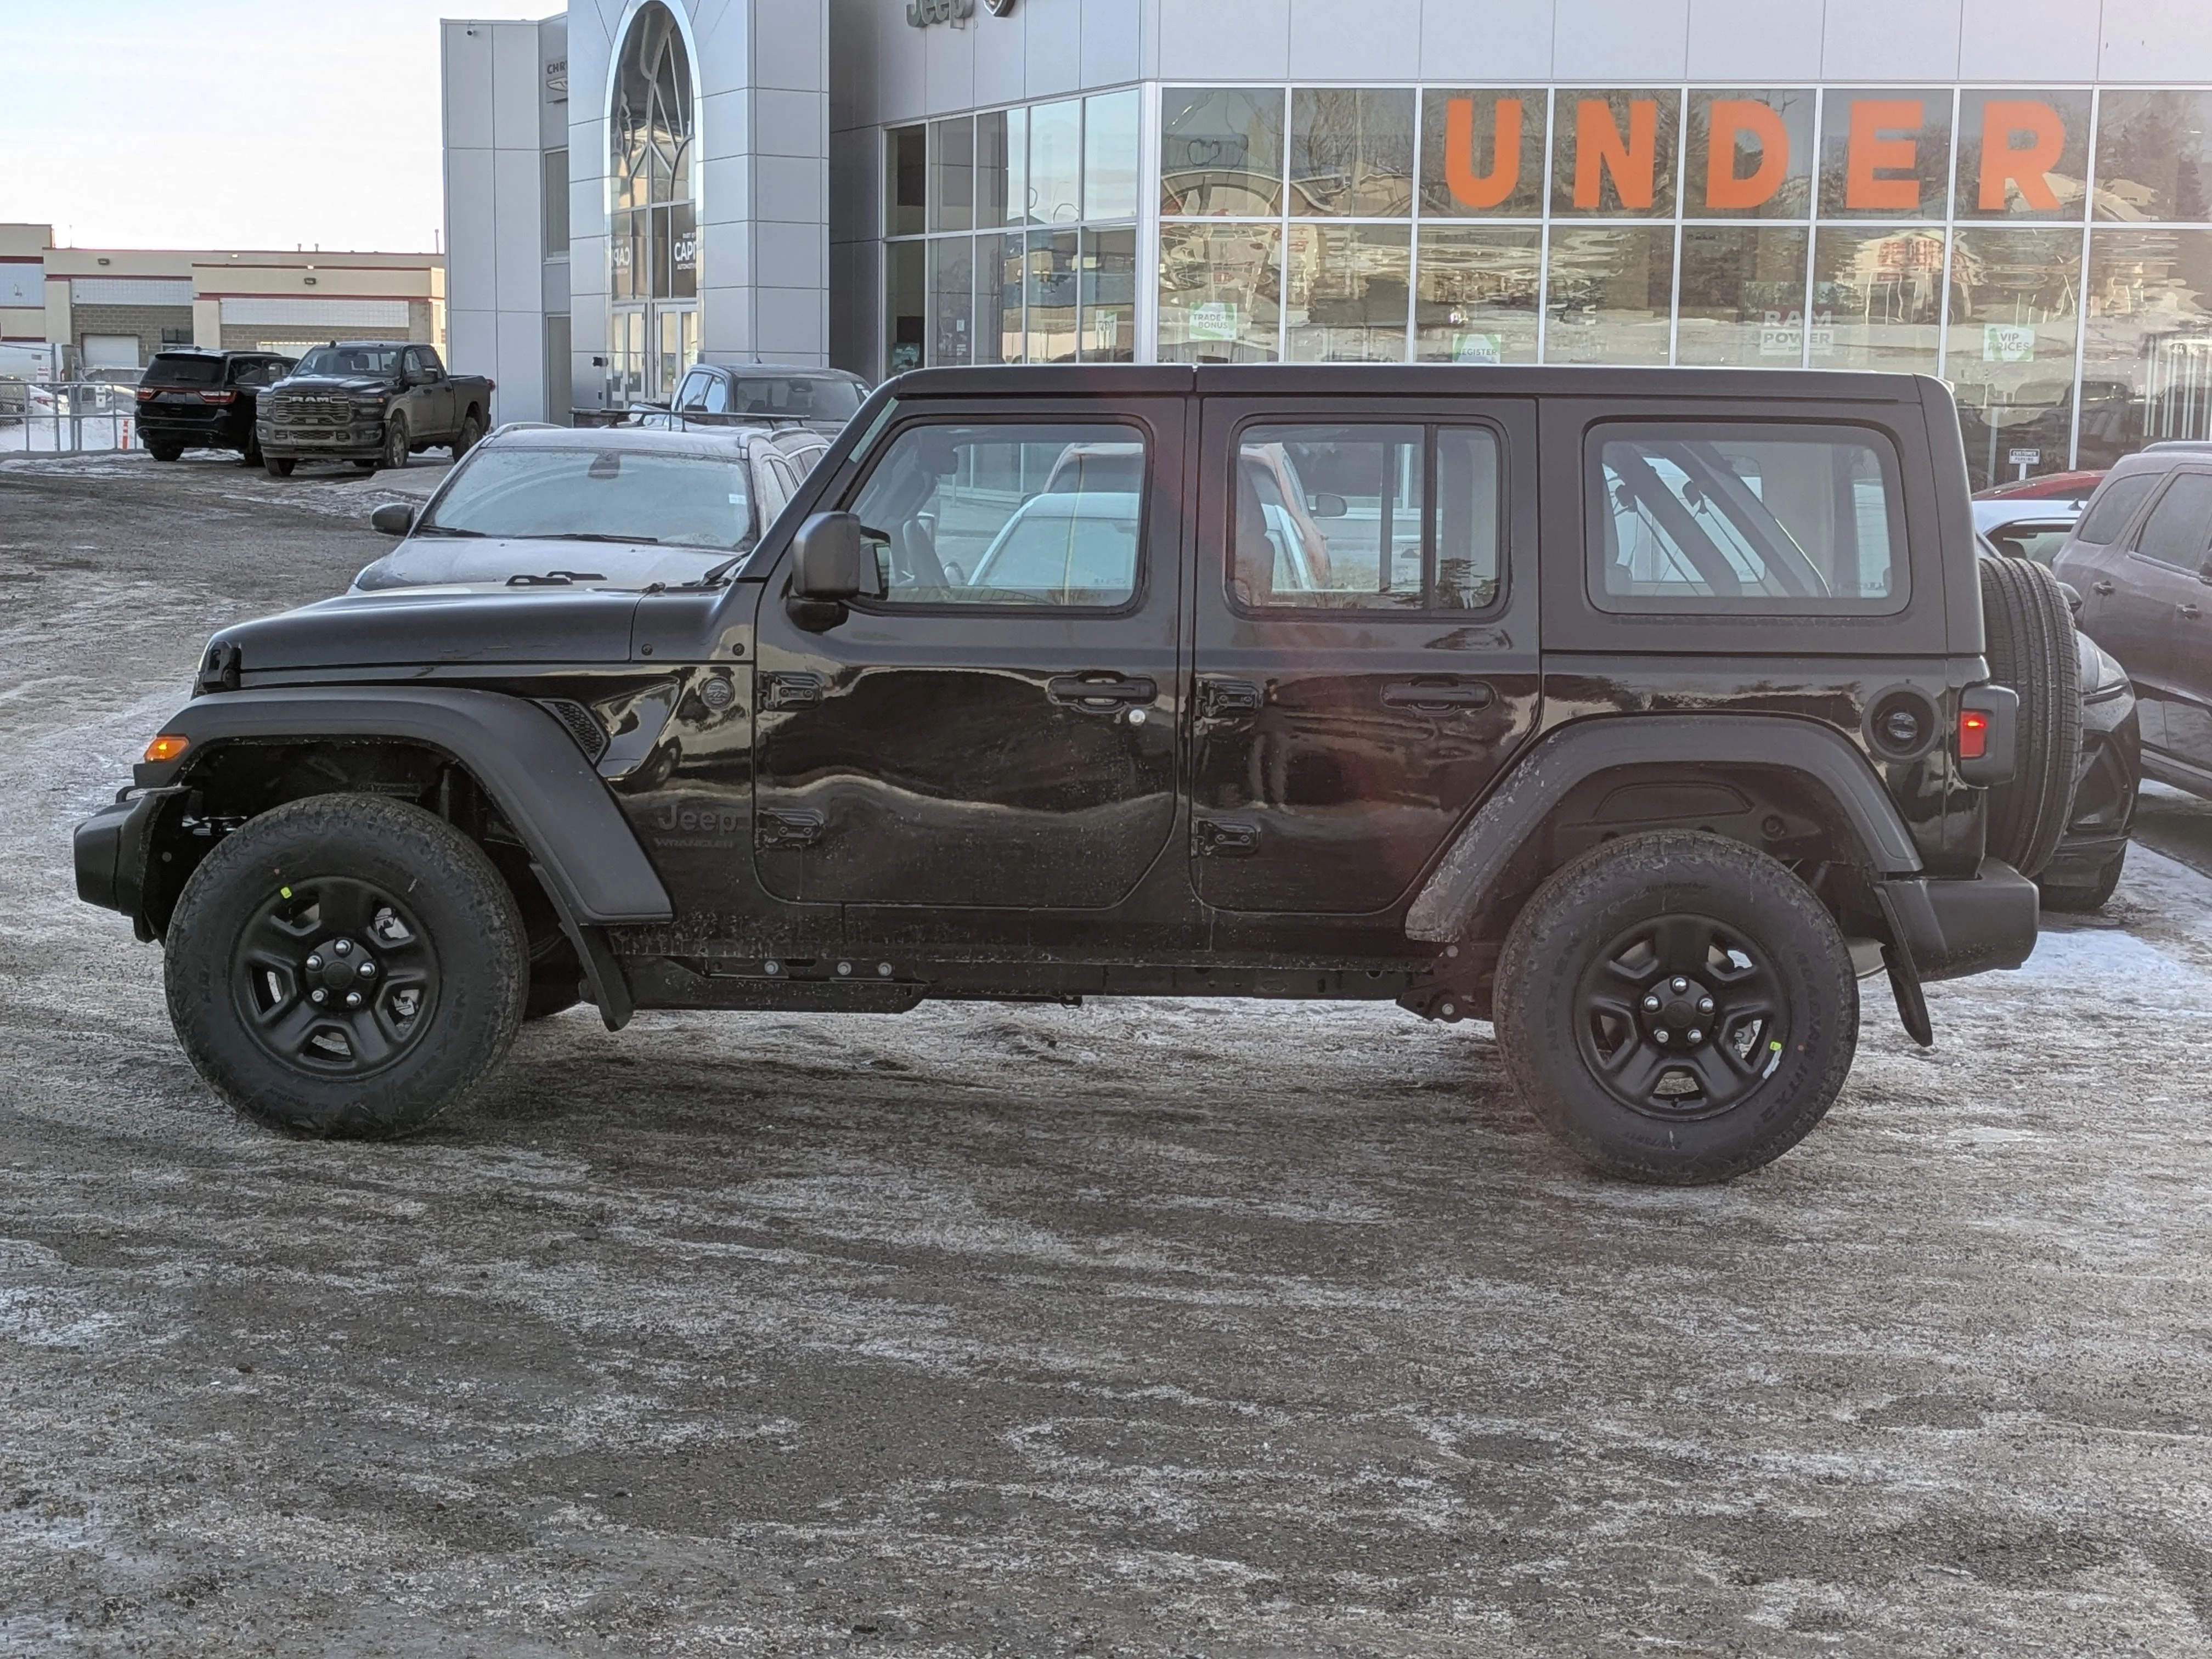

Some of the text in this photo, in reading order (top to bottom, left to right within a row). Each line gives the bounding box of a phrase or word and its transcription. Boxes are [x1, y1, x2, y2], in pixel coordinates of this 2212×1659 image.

[547, 61, 567, 74] CHR
[1445, 99, 2065, 210] UNDER
[674, 241, 696, 261] CAPI
[1764, 311, 1831, 327] RAM
[1764, 332, 1830, 343] POWER
[2000, 333, 2019, 341] VIP
[1988, 342, 2029, 351] PRICES
[658, 805, 737, 837] Jeep
